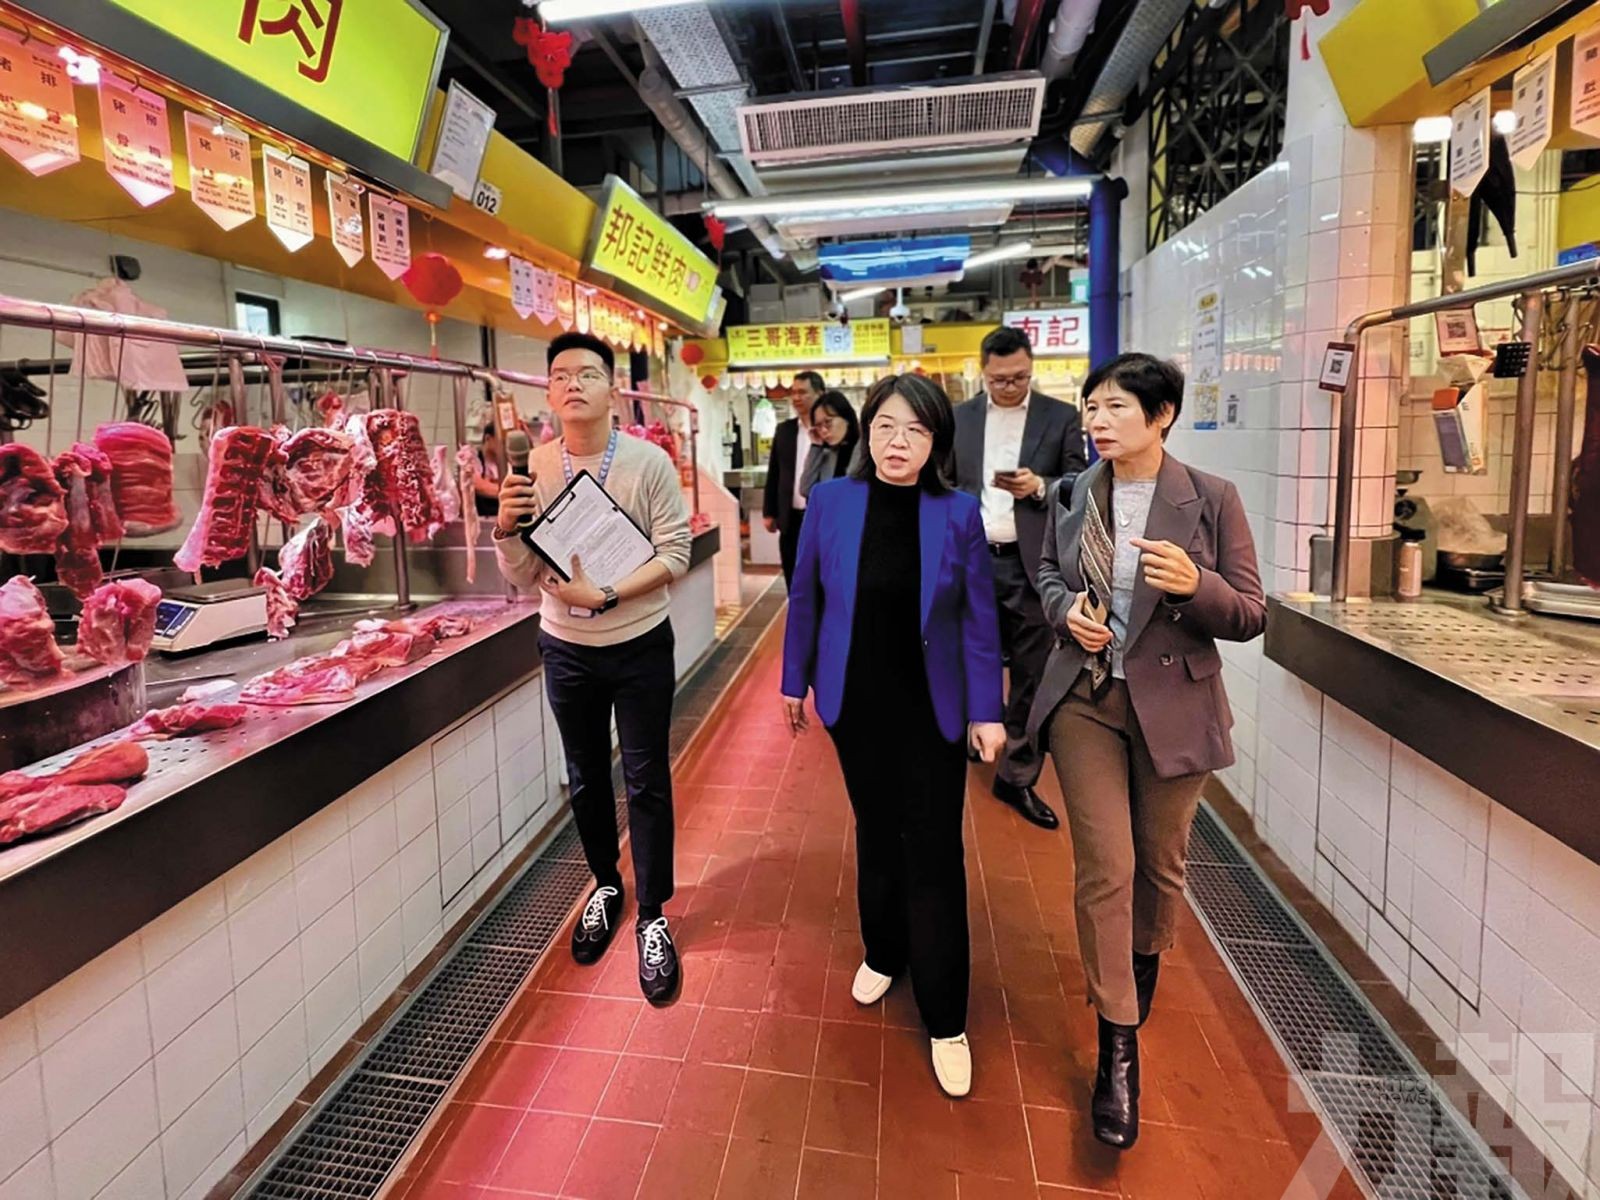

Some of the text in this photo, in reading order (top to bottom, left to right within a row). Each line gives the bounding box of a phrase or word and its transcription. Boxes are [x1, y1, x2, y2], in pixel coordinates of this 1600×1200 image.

[476, 191, 498, 214] 012
[603, 204, 687, 296] 邦記鮮肉
[746, 324, 821, 348] 三哥海產
[1011, 315, 1080, 348] 南記
